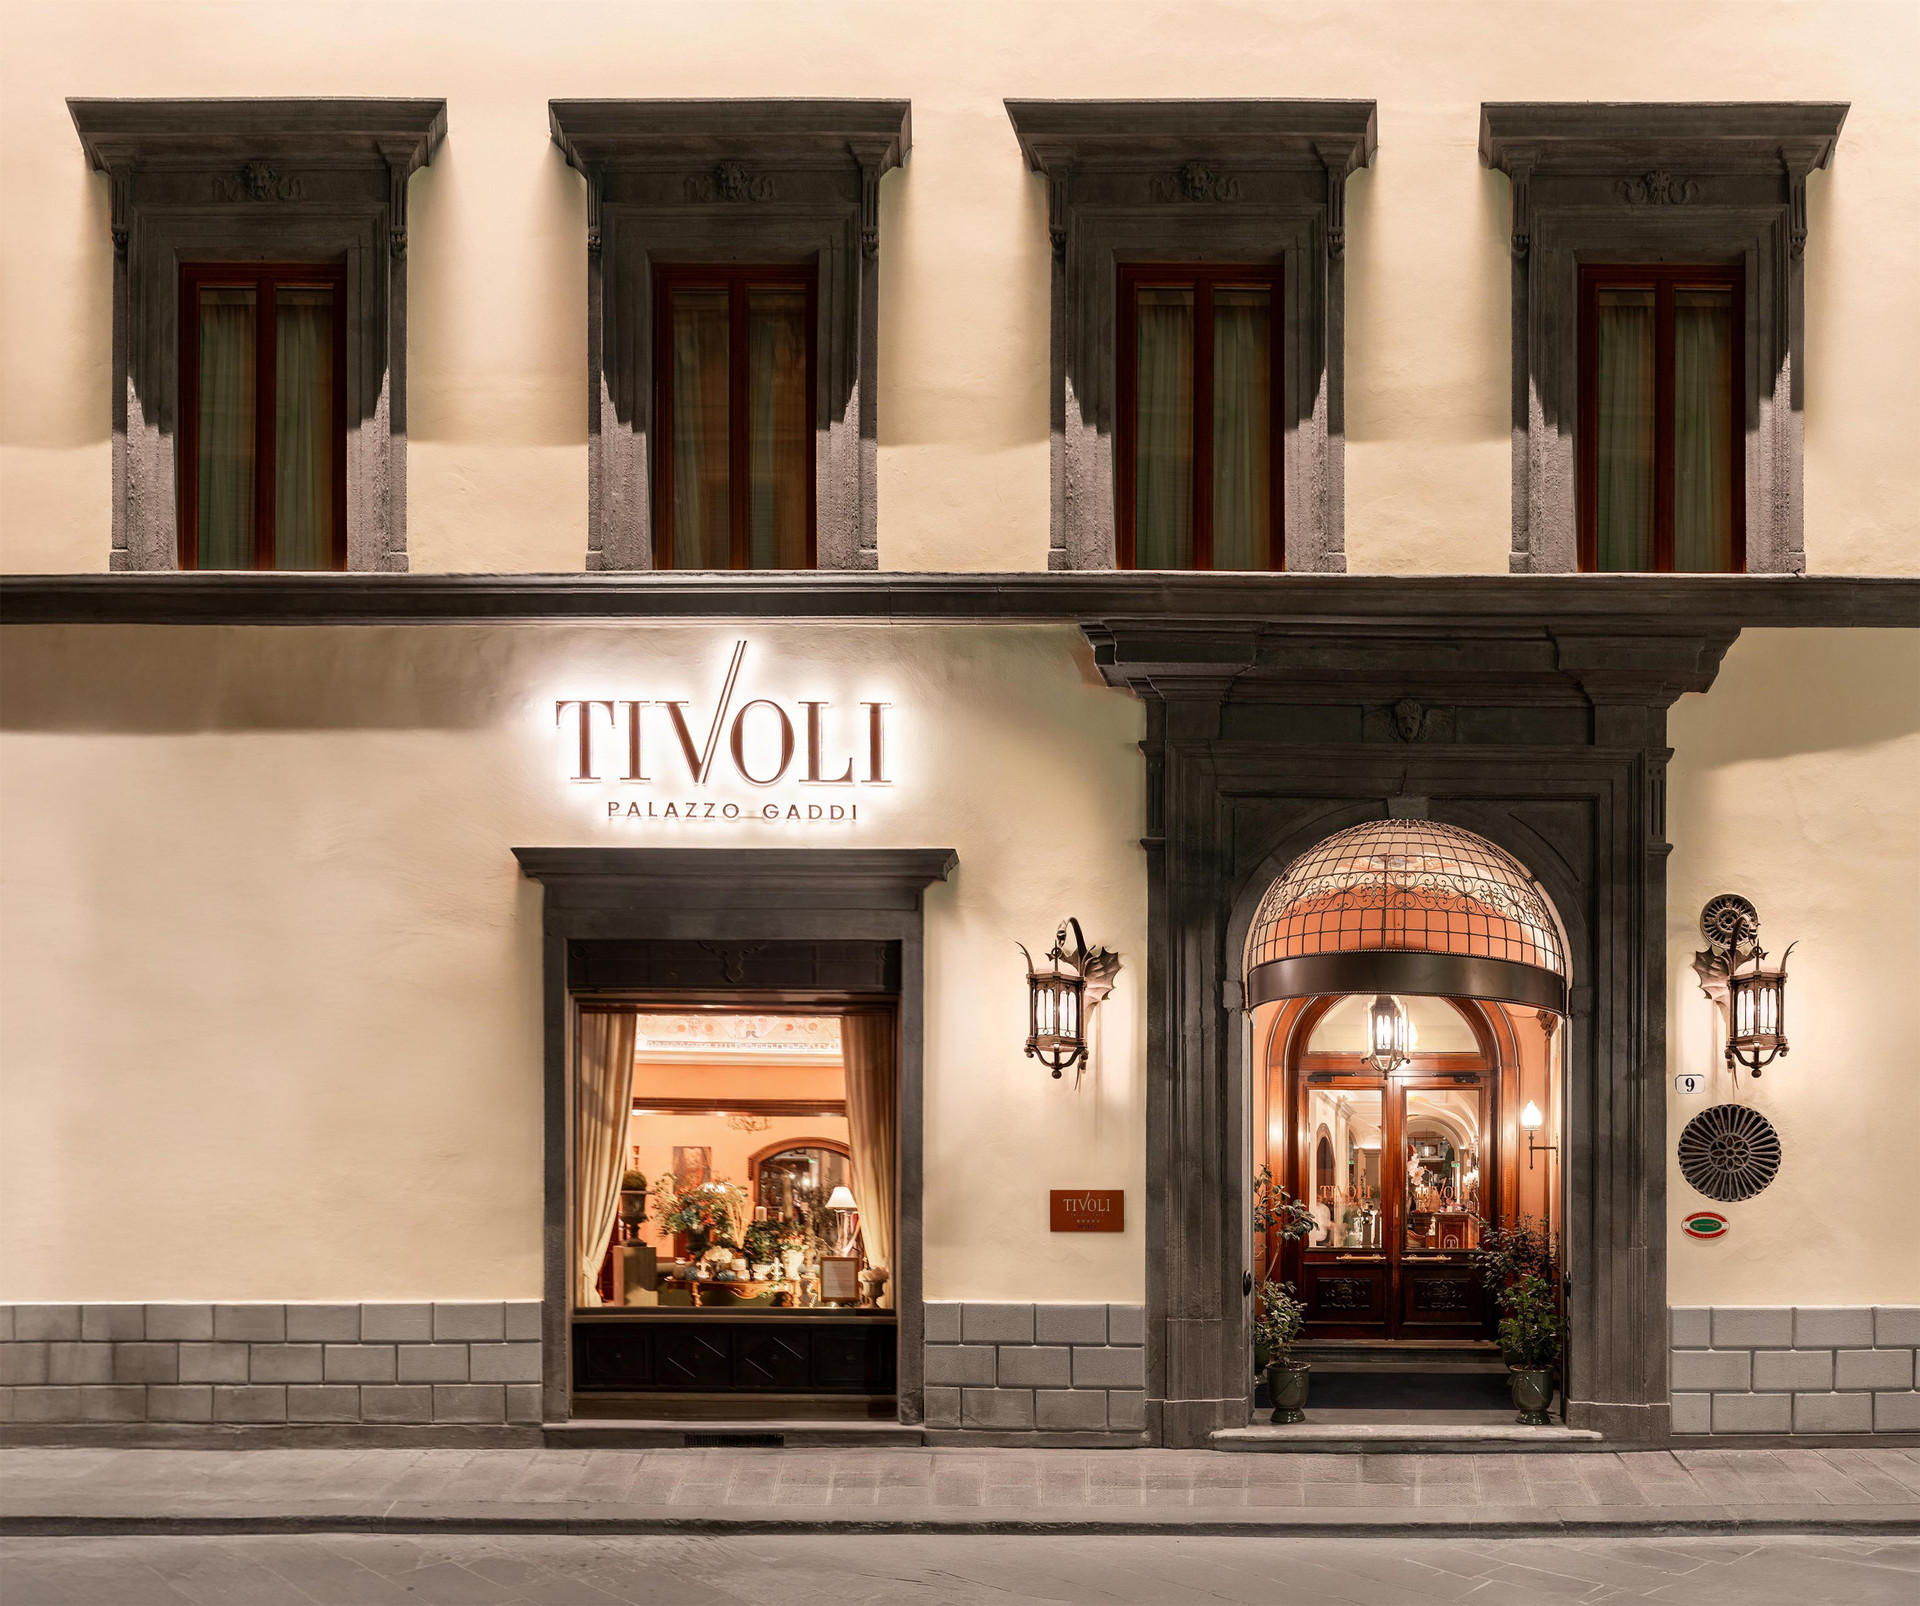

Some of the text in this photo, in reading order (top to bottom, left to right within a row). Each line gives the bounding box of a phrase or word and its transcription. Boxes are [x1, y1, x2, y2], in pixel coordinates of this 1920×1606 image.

[556, 640, 892, 785] TIVOLI
[608, 801, 857, 820] PALAZZO GADDI
[1685, 1077, 1695, 1092] 9
[1063, 1192, 1110, 1212] TIVOLI
